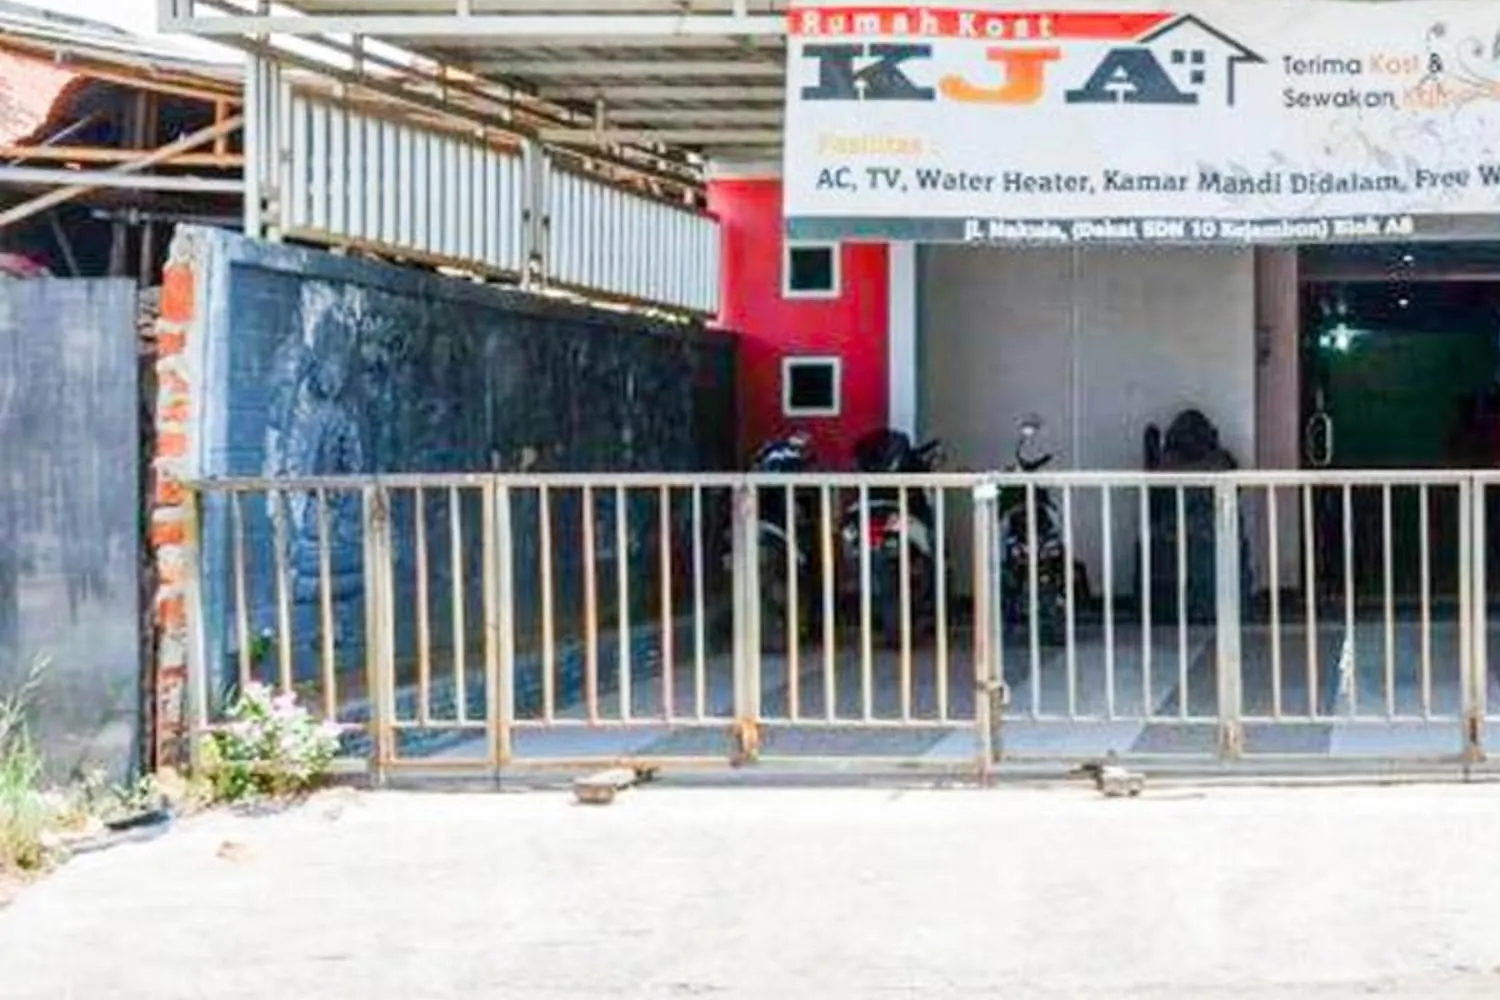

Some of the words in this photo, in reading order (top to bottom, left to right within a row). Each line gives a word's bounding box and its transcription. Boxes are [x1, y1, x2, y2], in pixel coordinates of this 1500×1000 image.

[802, 8, 939, 36] Rumah
[958, 11, 1054, 38] Kost
[801, 43, 1198, 105] KJA
[1282, 54, 1362, 75] Terima
[1283, 87, 1396, 108] Sewakan
[816, 167, 858, 192] AC,
[866, 167, 908, 192] TV,
[915, 168, 995, 192] Water
[1003, 171, 1096, 195] Heater,
[1102, 169, 1188, 192] Kamar
[1199, 171, 1281, 194] Mandi
[1290, 169, 1408, 194] Didalam,
[1415, 168, 1470, 189] Free
